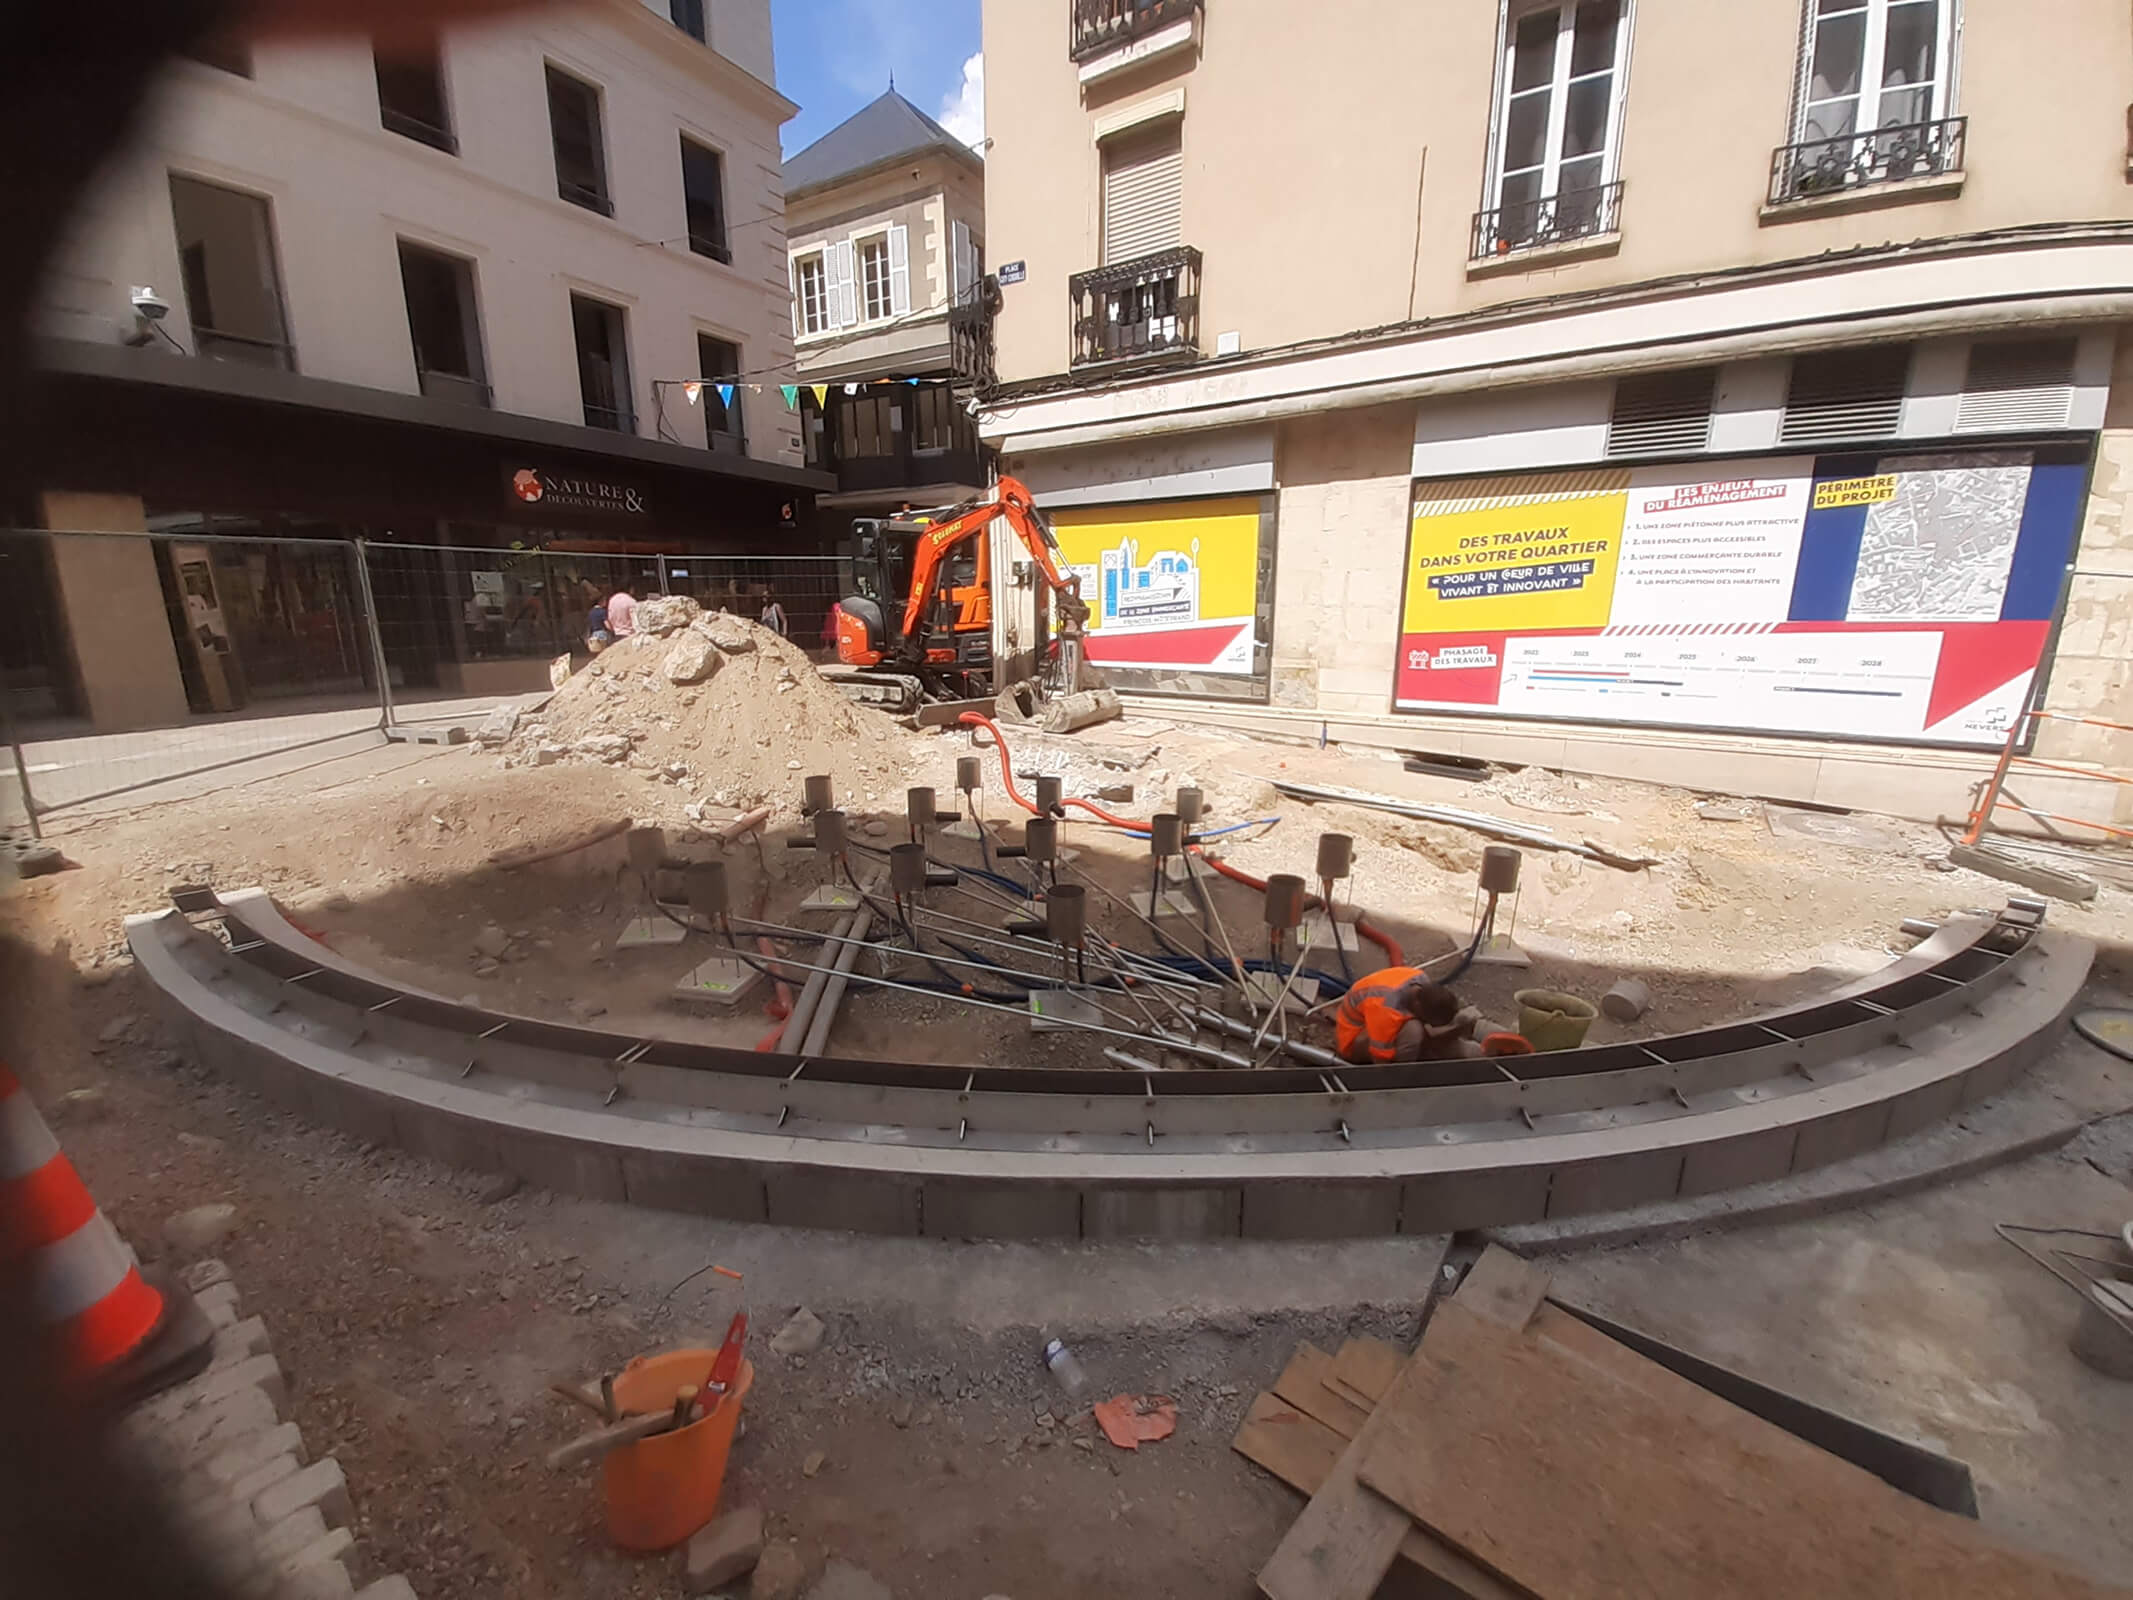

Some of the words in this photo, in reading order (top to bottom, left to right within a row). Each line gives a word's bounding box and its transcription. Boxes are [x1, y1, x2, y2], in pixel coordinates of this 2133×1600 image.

[545, 475, 623, 500] NATURE
[1676, 486, 1698, 498] LES
[1701, 480, 1752, 494] ENJEUX
[1816, 494, 1837, 505] DU
[1841, 488, 1895, 502] PROJET
[1646, 501, 1665, 512] DU
[1746, 518, 1800, 526] ATTRACTIVE
[1459, 535, 1489, 549] DES
[1492, 527, 1570, 546] TRAVAUX
[1420, 554, 1461, 569] DANS
[1465, 548, 1518, 564] VOTRE
[1520, 540, 1609, 559] QUARTIER
[1442, 570, 1476, 585] POUR
[1479, 571, 1498, 581] UN
[1537, 565, 1555, 576] DE
[1559, 562, 1590, 573] VILLE
[1441, 585, 1483, 597] VIVANT
[1487, 583, 1500, 594] ET
[1503, 578, 1569, 592] INNOVANT
[1443, 647, 1484, 656] PHASAGE
[1453, 656, 1494, 664] TRAVAUX
